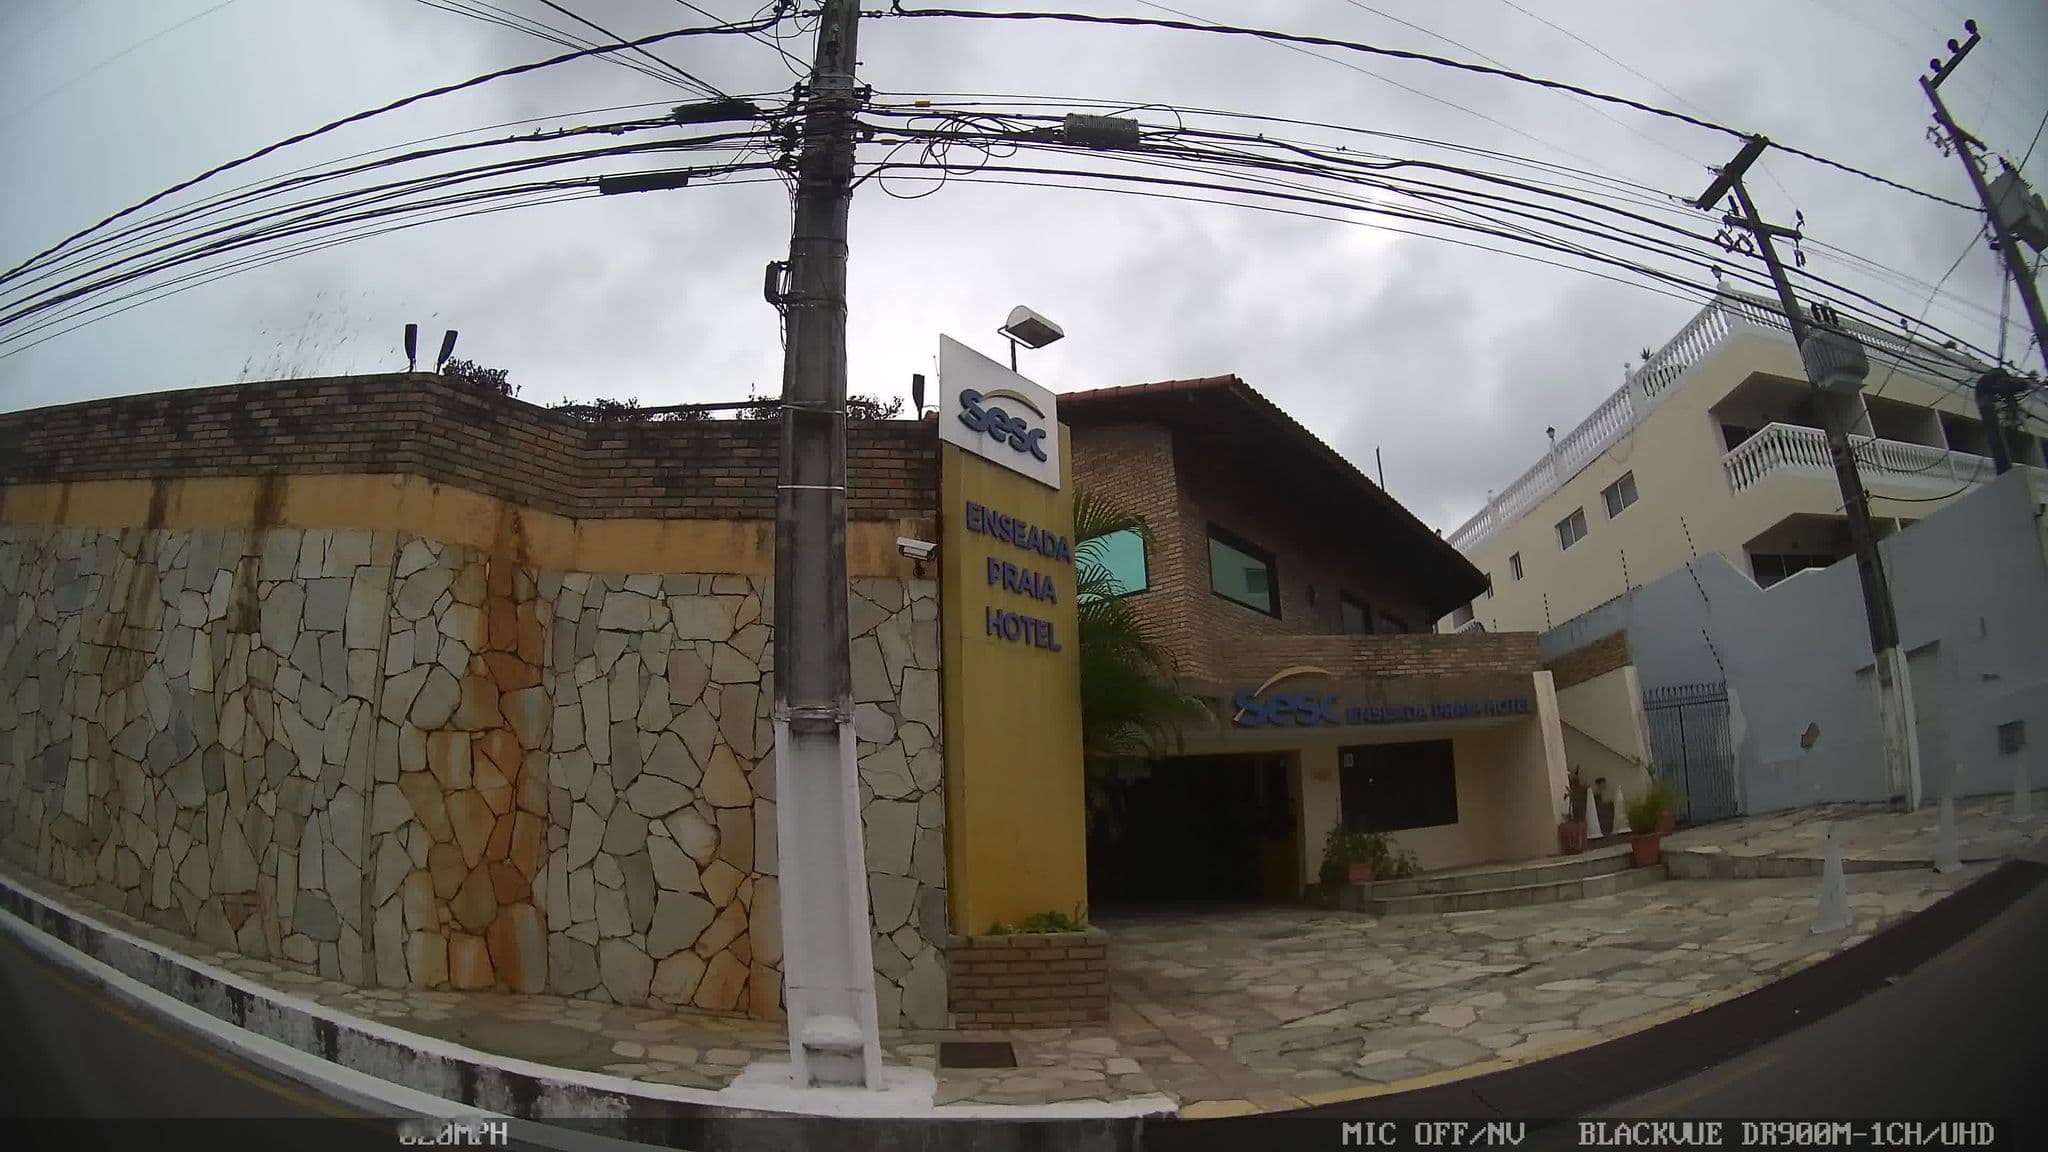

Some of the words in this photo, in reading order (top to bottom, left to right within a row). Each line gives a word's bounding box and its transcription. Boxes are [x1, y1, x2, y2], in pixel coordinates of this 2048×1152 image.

[966, 501, 1073, 564] ENSEADA
[987, 556, 1057, 604] PRAIA
[985, 606, 1062, 652] HOTEL
